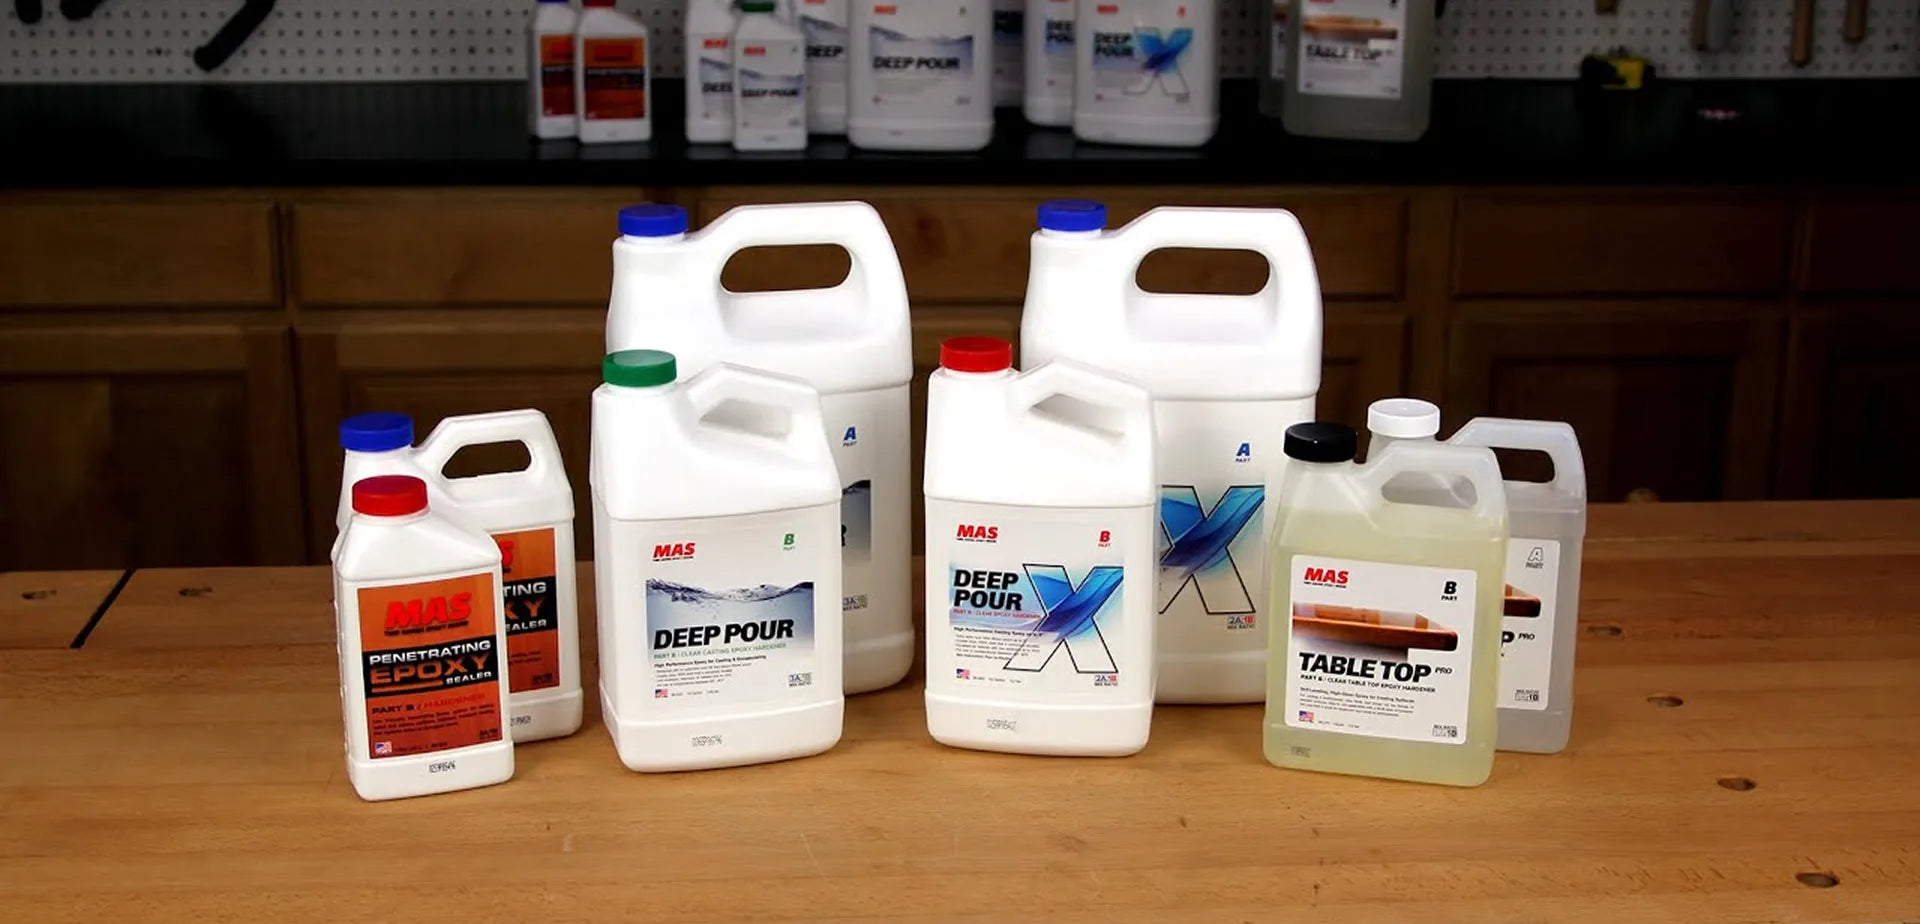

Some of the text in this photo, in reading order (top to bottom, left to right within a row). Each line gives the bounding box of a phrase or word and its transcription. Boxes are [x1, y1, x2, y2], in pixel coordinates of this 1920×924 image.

[1047, 20, 1073, 31] DEE
[1094, 33, 1131, 44] DEEP
[873, 56, 960, 69] DEEP POUR
[843, 426, 857, 440] A
[1236, 443, 1250, 456] A
[957, 524, 998, 539] MAS
[1099, 530, 1111, 542] B
[784, 533, 795, 545] B
[653, 543, 696, 558] MAS
[1528, 547, 1543, 561] A
[953, 569, 1019, 590] DEEP
[1304, 567, 1348, 584] MAS
[1444, 581, 1457, 594] B
[953, 589, 1023, 611] POUR
[385, 592, 472, 628] MAS
[506, 619, 547, 632] EALER
[653, 619, 795, 650] DEEP POUR
[1518, 633, 1536, 641] PRO
[370, 640, 491, 665] PENETRATING
[681, 650, 702, 658] CLEAR
[703, 648, 730, 656] CASTING
[731, 646, 752, 654] EPOXY
[370, 653, 490, 684] EPOXY
[1299, 652, 1453, 683] TABLE TOP PRO
[446, 671, 492, 685] SEALER
[1348, 679, 1366, 687] TABLE
[1381, 682, 1401, 690] EPOXY
[1402, 685, 1435, 693] HARDENER
